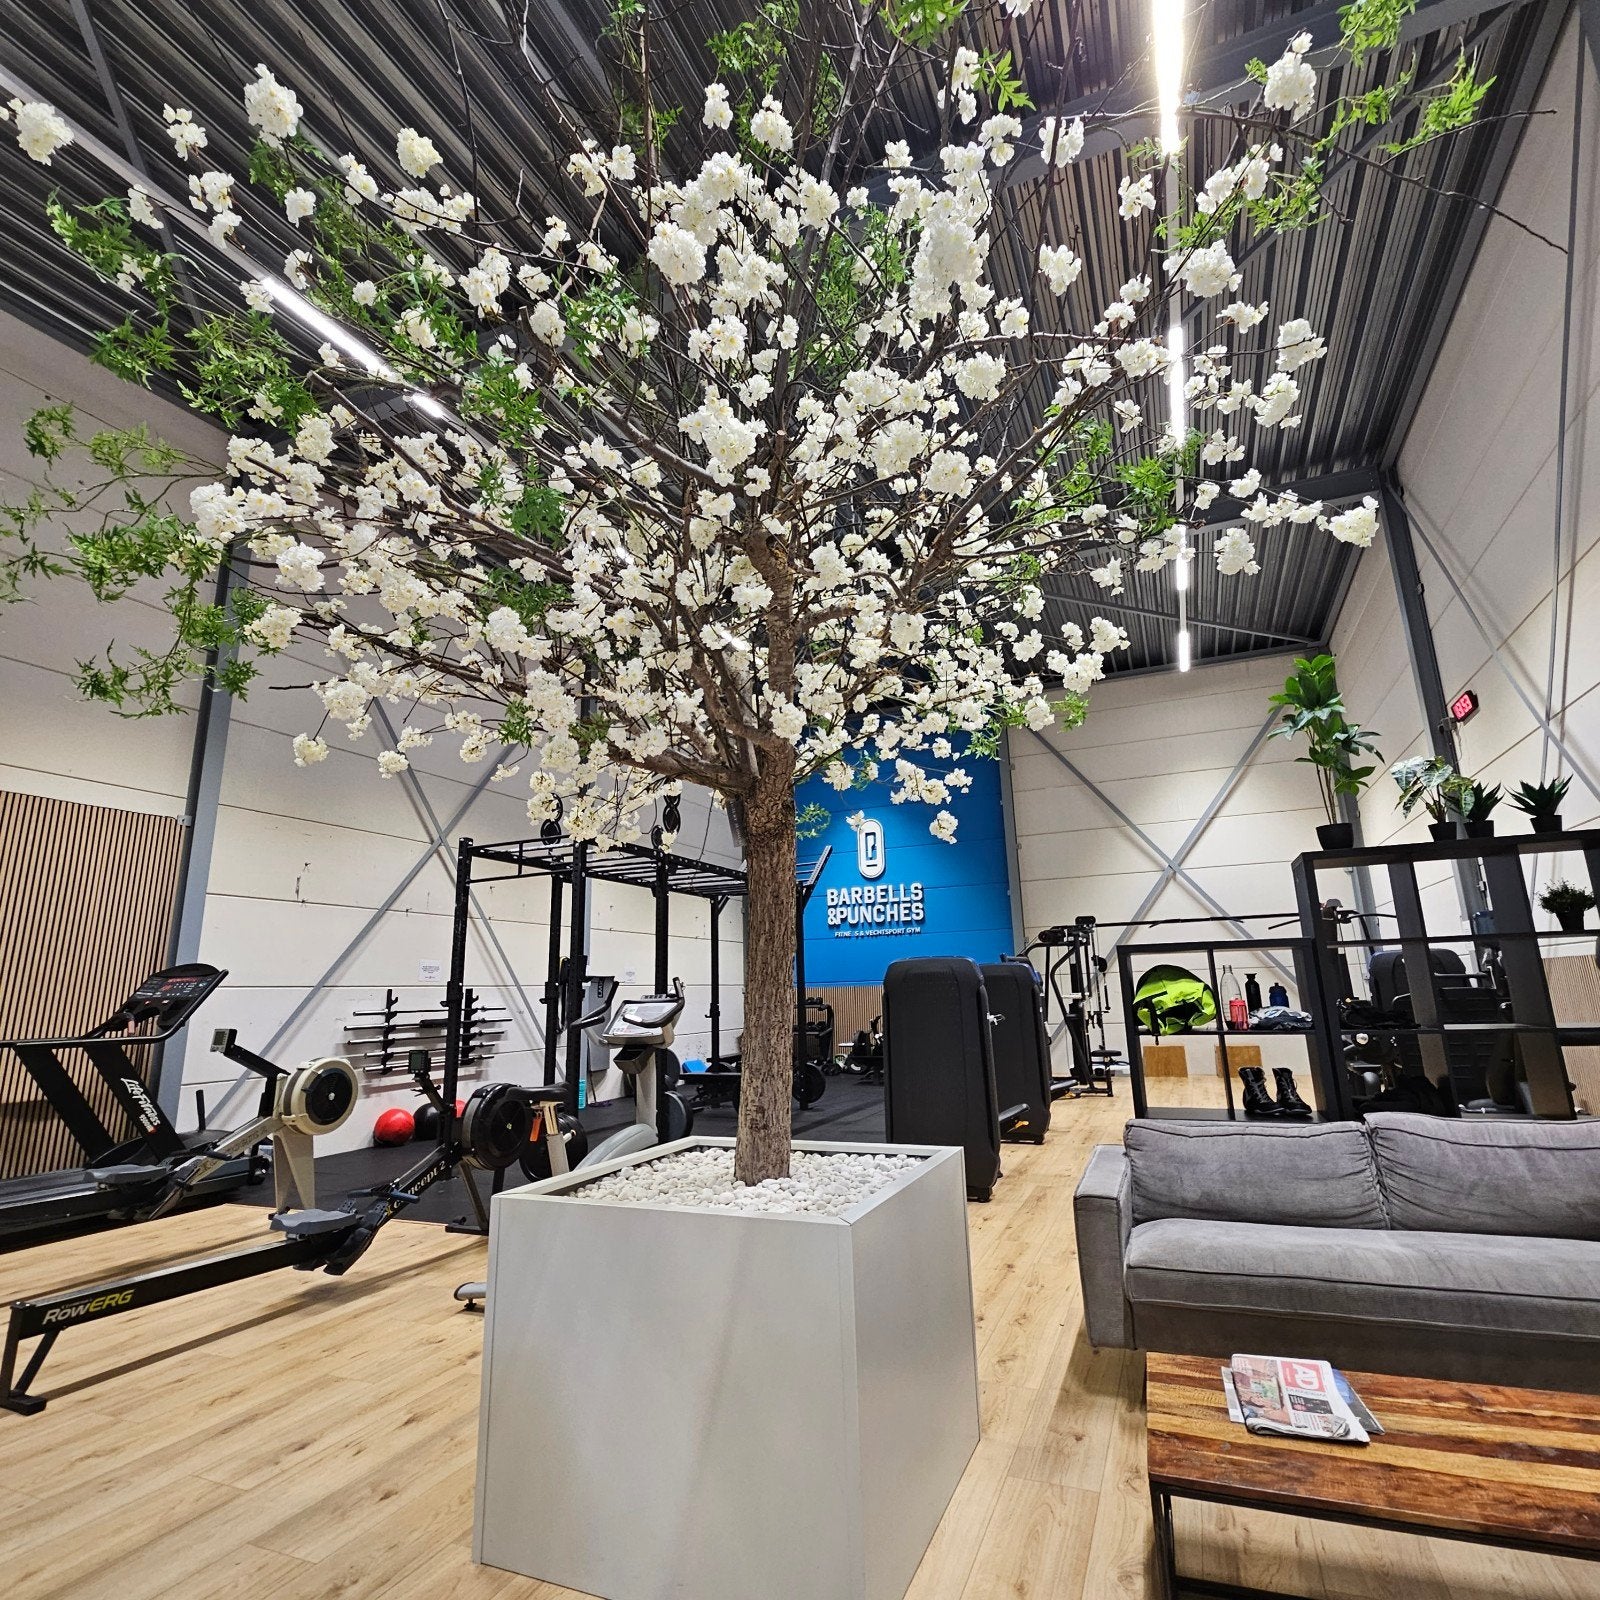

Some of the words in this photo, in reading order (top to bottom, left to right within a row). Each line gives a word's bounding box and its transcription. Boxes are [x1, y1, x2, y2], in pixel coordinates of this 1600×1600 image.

[827, 883, 923, 906] BARBELLS
[828, 902, 924, 925] &PUNCHES
[865, 927, 906, 936] VECHTSPORT
[393, 1167, 438, 1209] cncept
[439, 1160, 446, 1171] 2
